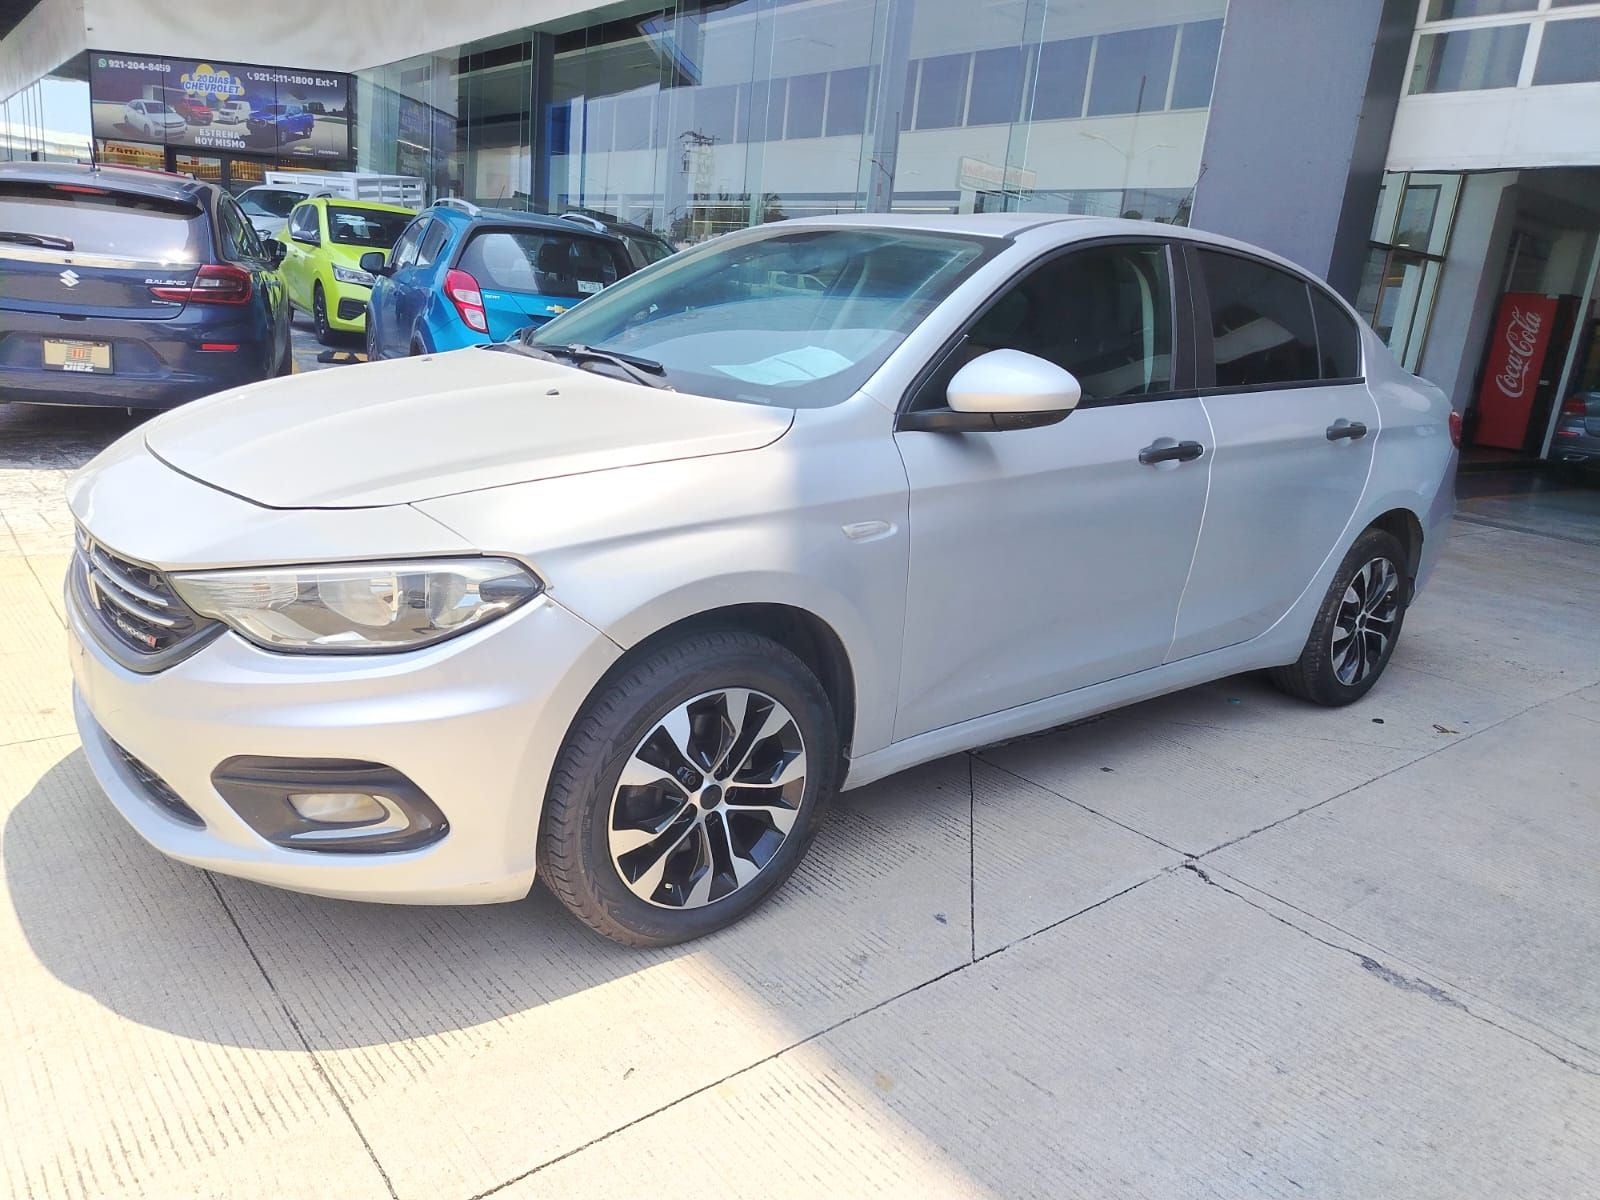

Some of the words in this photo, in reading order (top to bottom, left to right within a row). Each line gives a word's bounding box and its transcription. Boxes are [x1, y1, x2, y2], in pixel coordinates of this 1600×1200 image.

[197, 74, 208, 83] 20
[253, 72, 314, 86] 921-211-1800
[315, 78, 338, 88] Ext-1
[184, 81, 240, 94] CHEVROLET
[199, 128, 240, 140] ESTRENA
[195, 136, 213, 146] HOY
[215, 138, 246, 149] MISMO
[144, 278, 187, 286] BALENO
